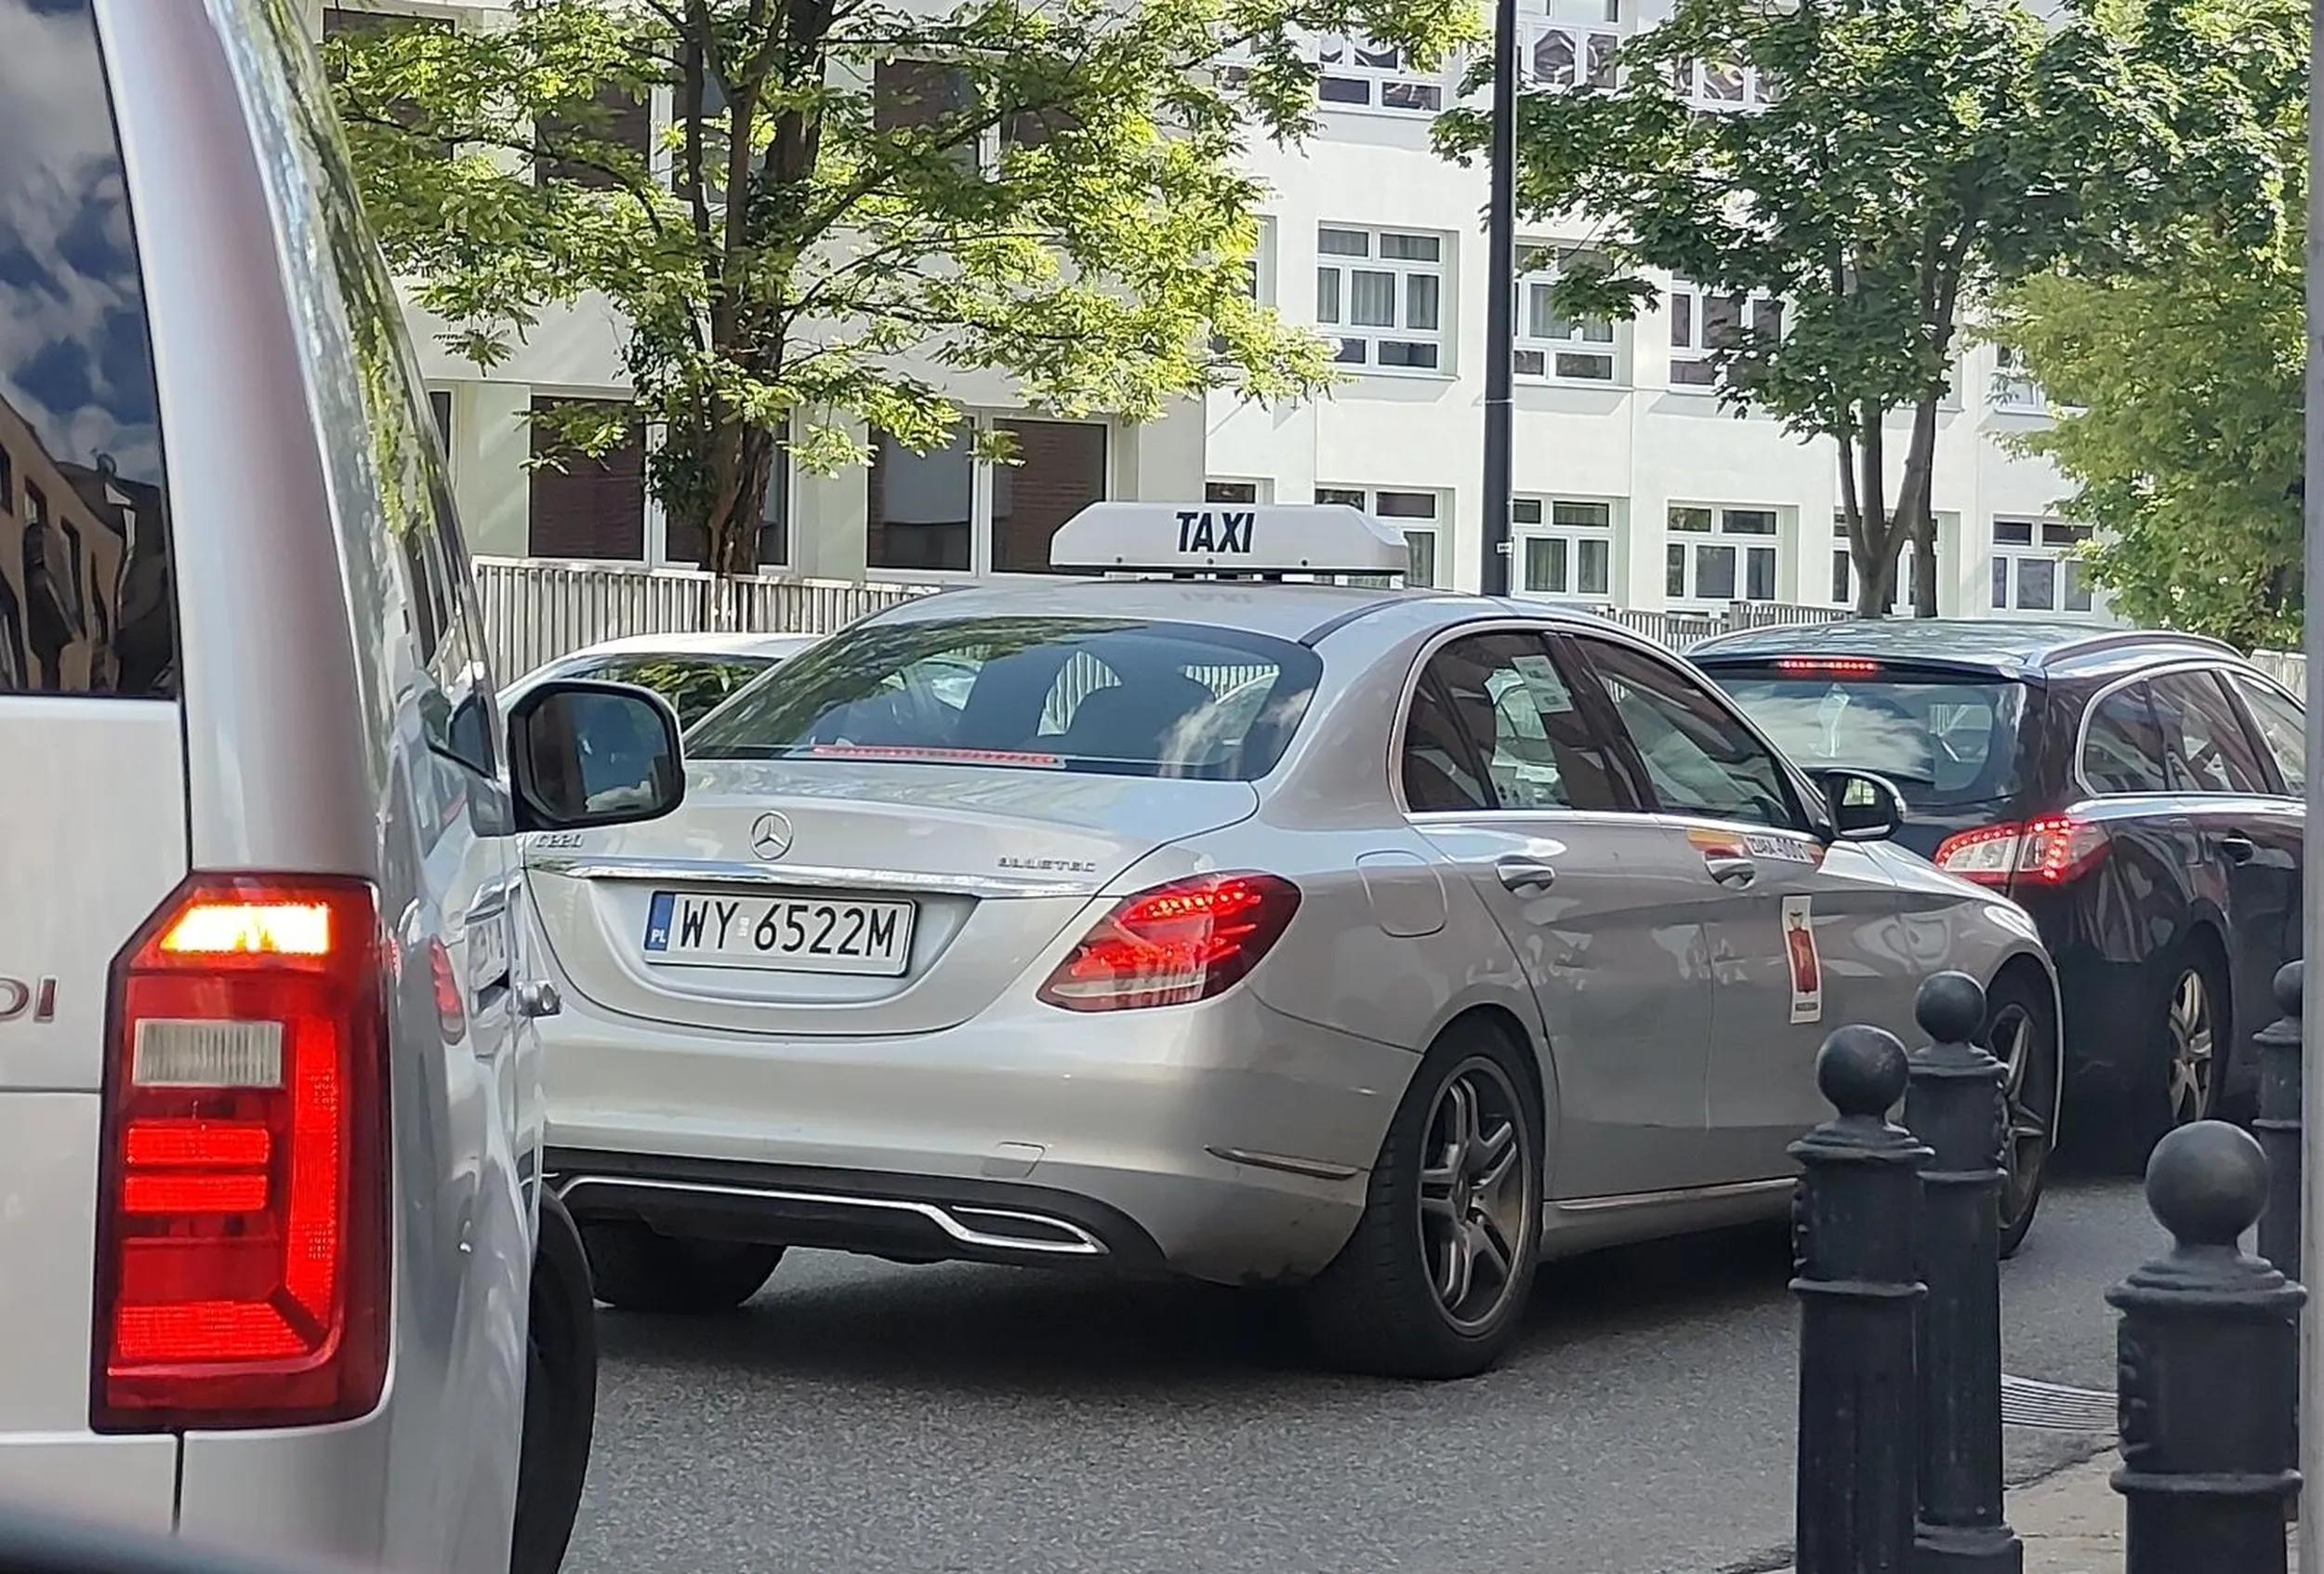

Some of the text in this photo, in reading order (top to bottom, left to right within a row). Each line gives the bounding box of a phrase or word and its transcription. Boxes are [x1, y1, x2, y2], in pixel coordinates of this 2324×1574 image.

[1176, 511, 1255, 554] TAXI
[651, 930, 667, 945] PL
[680, 899, 898, 958] WY 6522M
